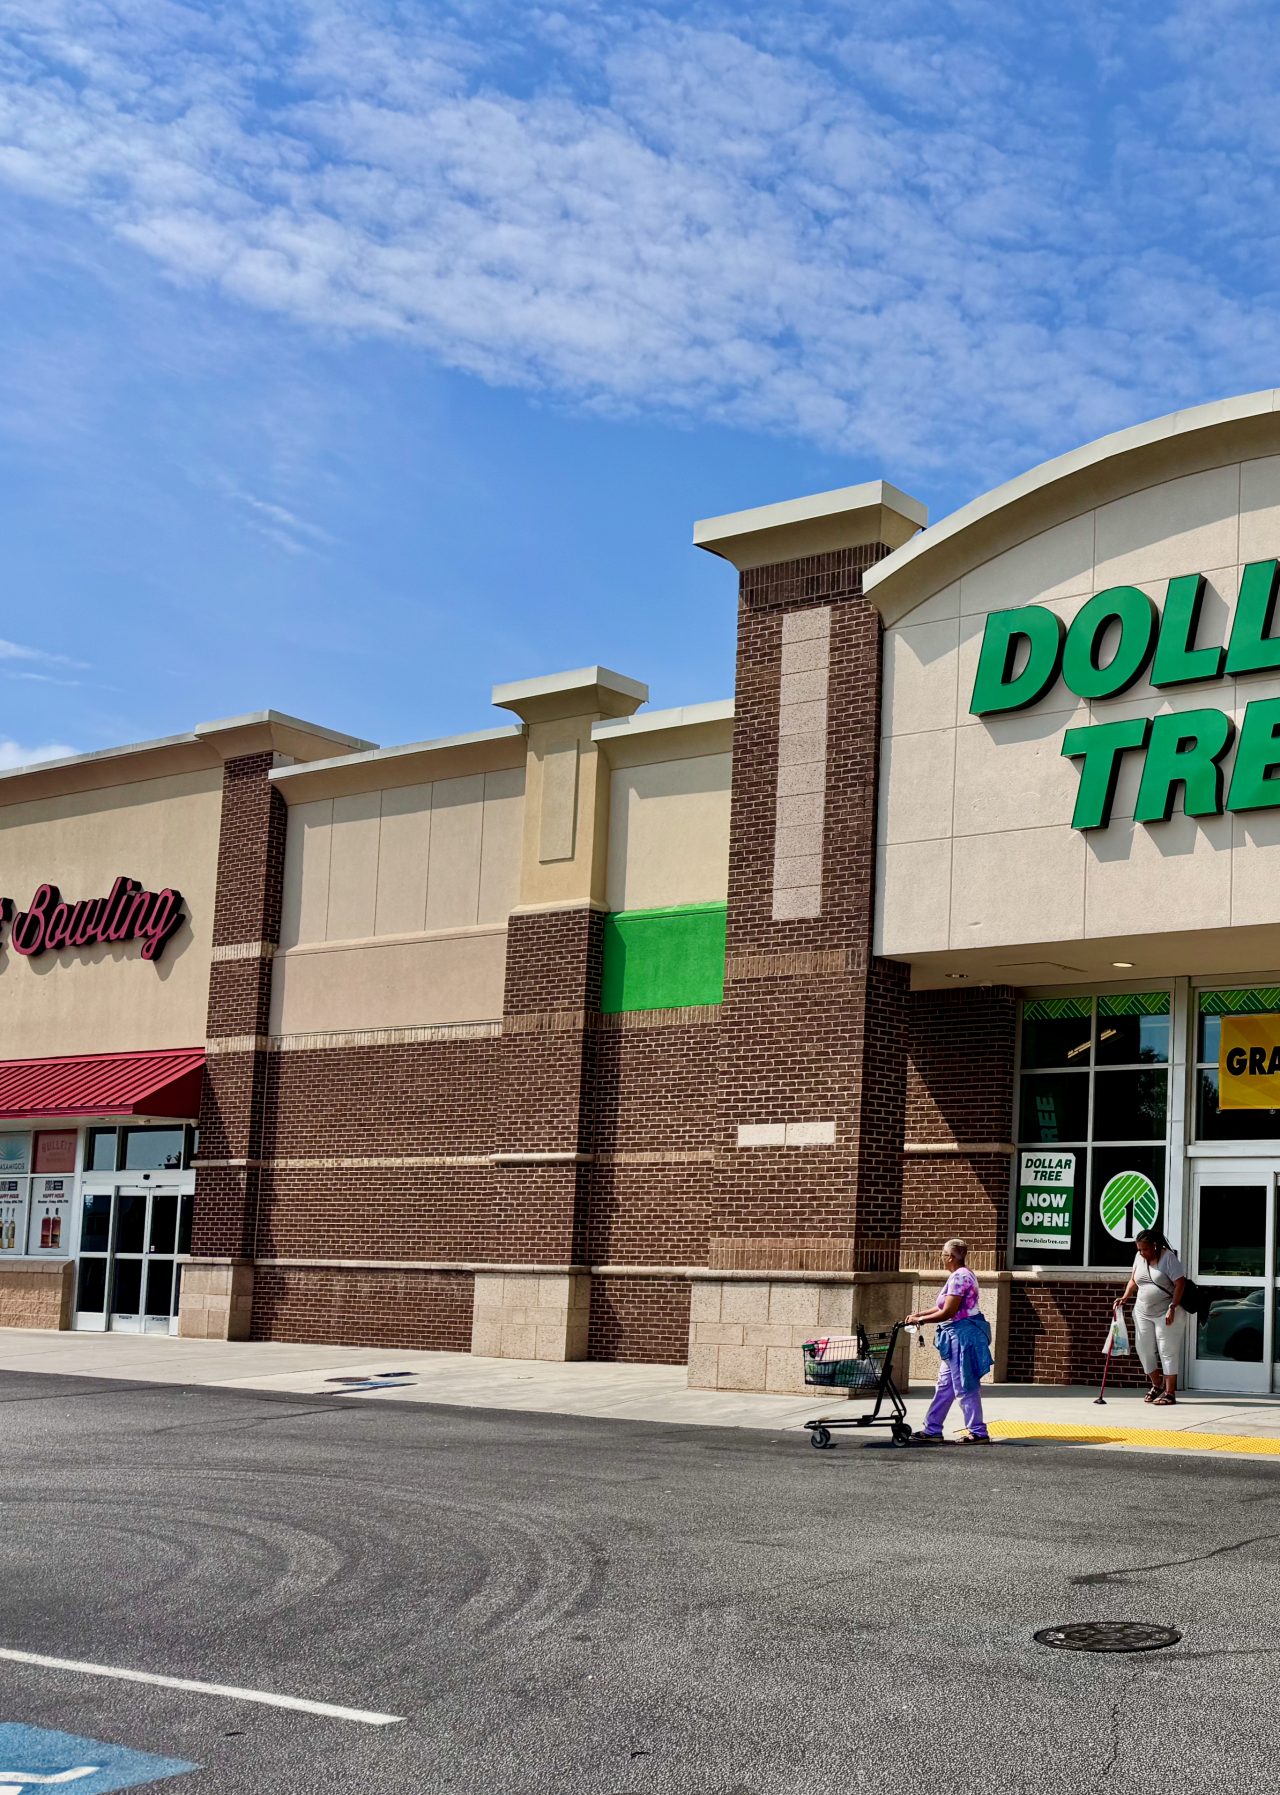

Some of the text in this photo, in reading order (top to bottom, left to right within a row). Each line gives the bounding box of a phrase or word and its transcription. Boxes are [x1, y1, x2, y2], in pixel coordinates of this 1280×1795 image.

[12, 876, 184, 960] Bowling
[1036, 1095, 1058, 1142] REE
[0, 1162, 25, 1170] ASAMIGOS
[1025, 1158, 1072, 1169] DOLLAR
[1033, 1170, 1062, 1181] TREE
[1026, 1193, 1067, 1208] NOW
[1021, 1211, 1069, 1227] OPEN!
